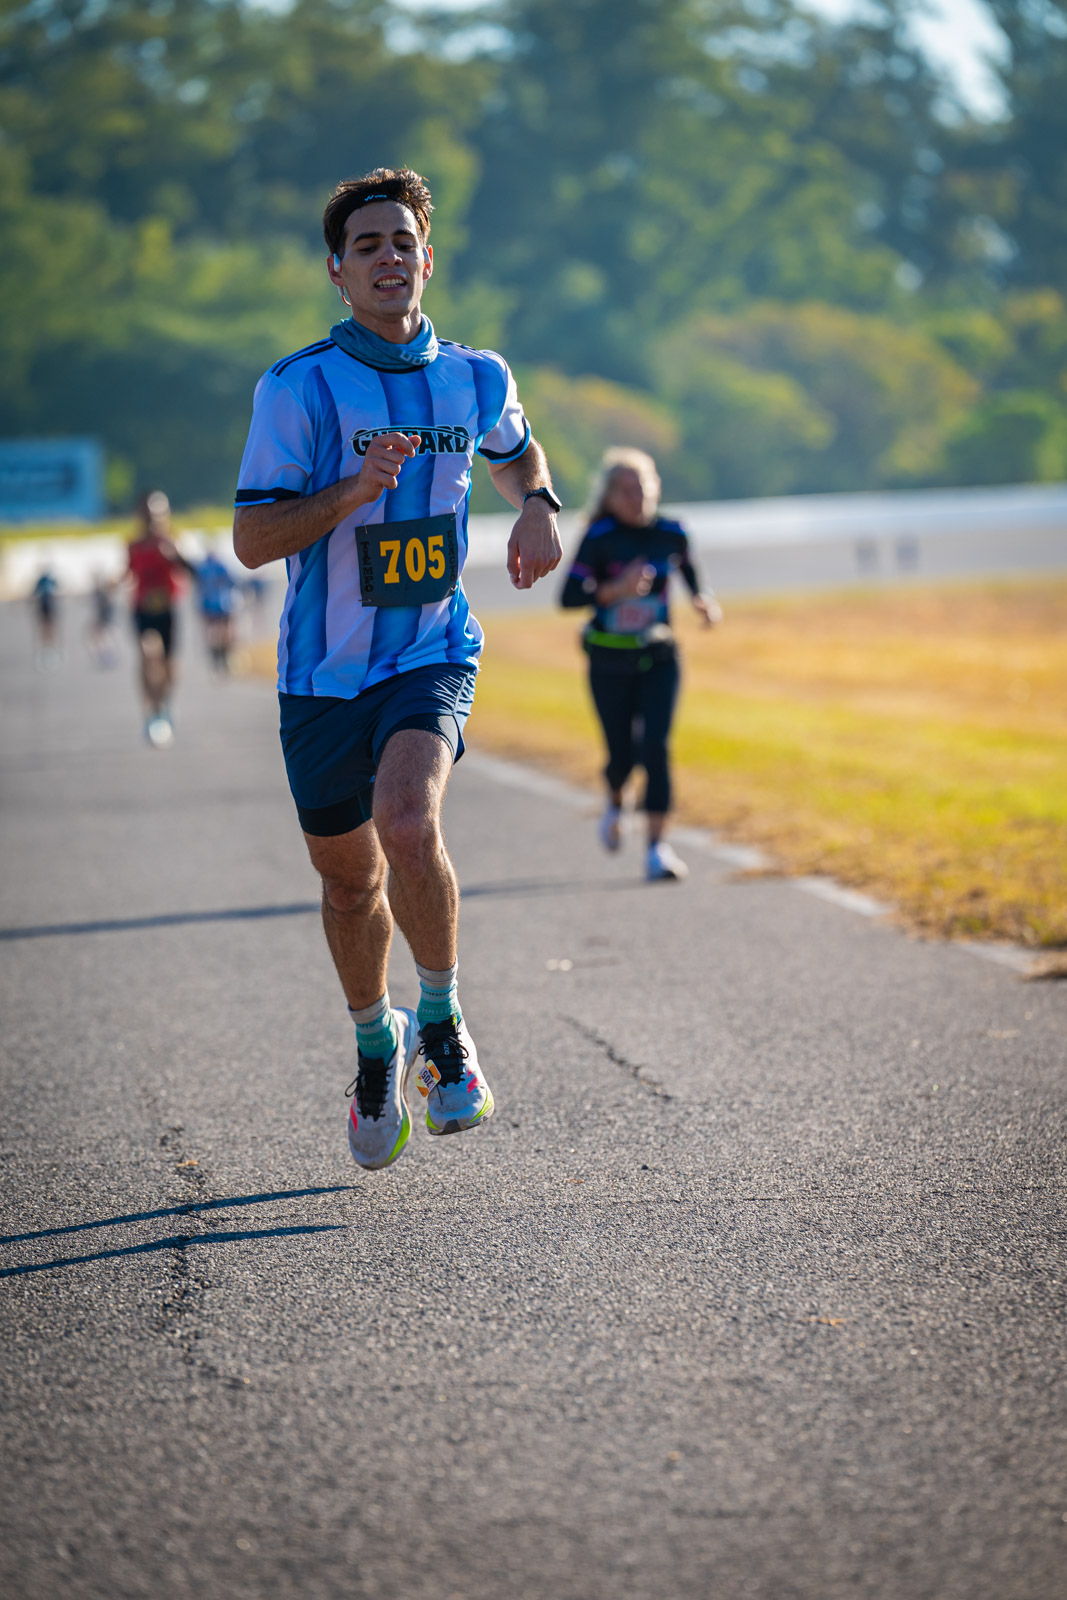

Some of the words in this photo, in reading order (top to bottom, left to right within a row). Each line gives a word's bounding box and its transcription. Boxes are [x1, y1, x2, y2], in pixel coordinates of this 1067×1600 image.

[351, 425, 470, 457] GARD
[380, 535, 446, 584] 705
[421, 1070, 435, 1087] 705
